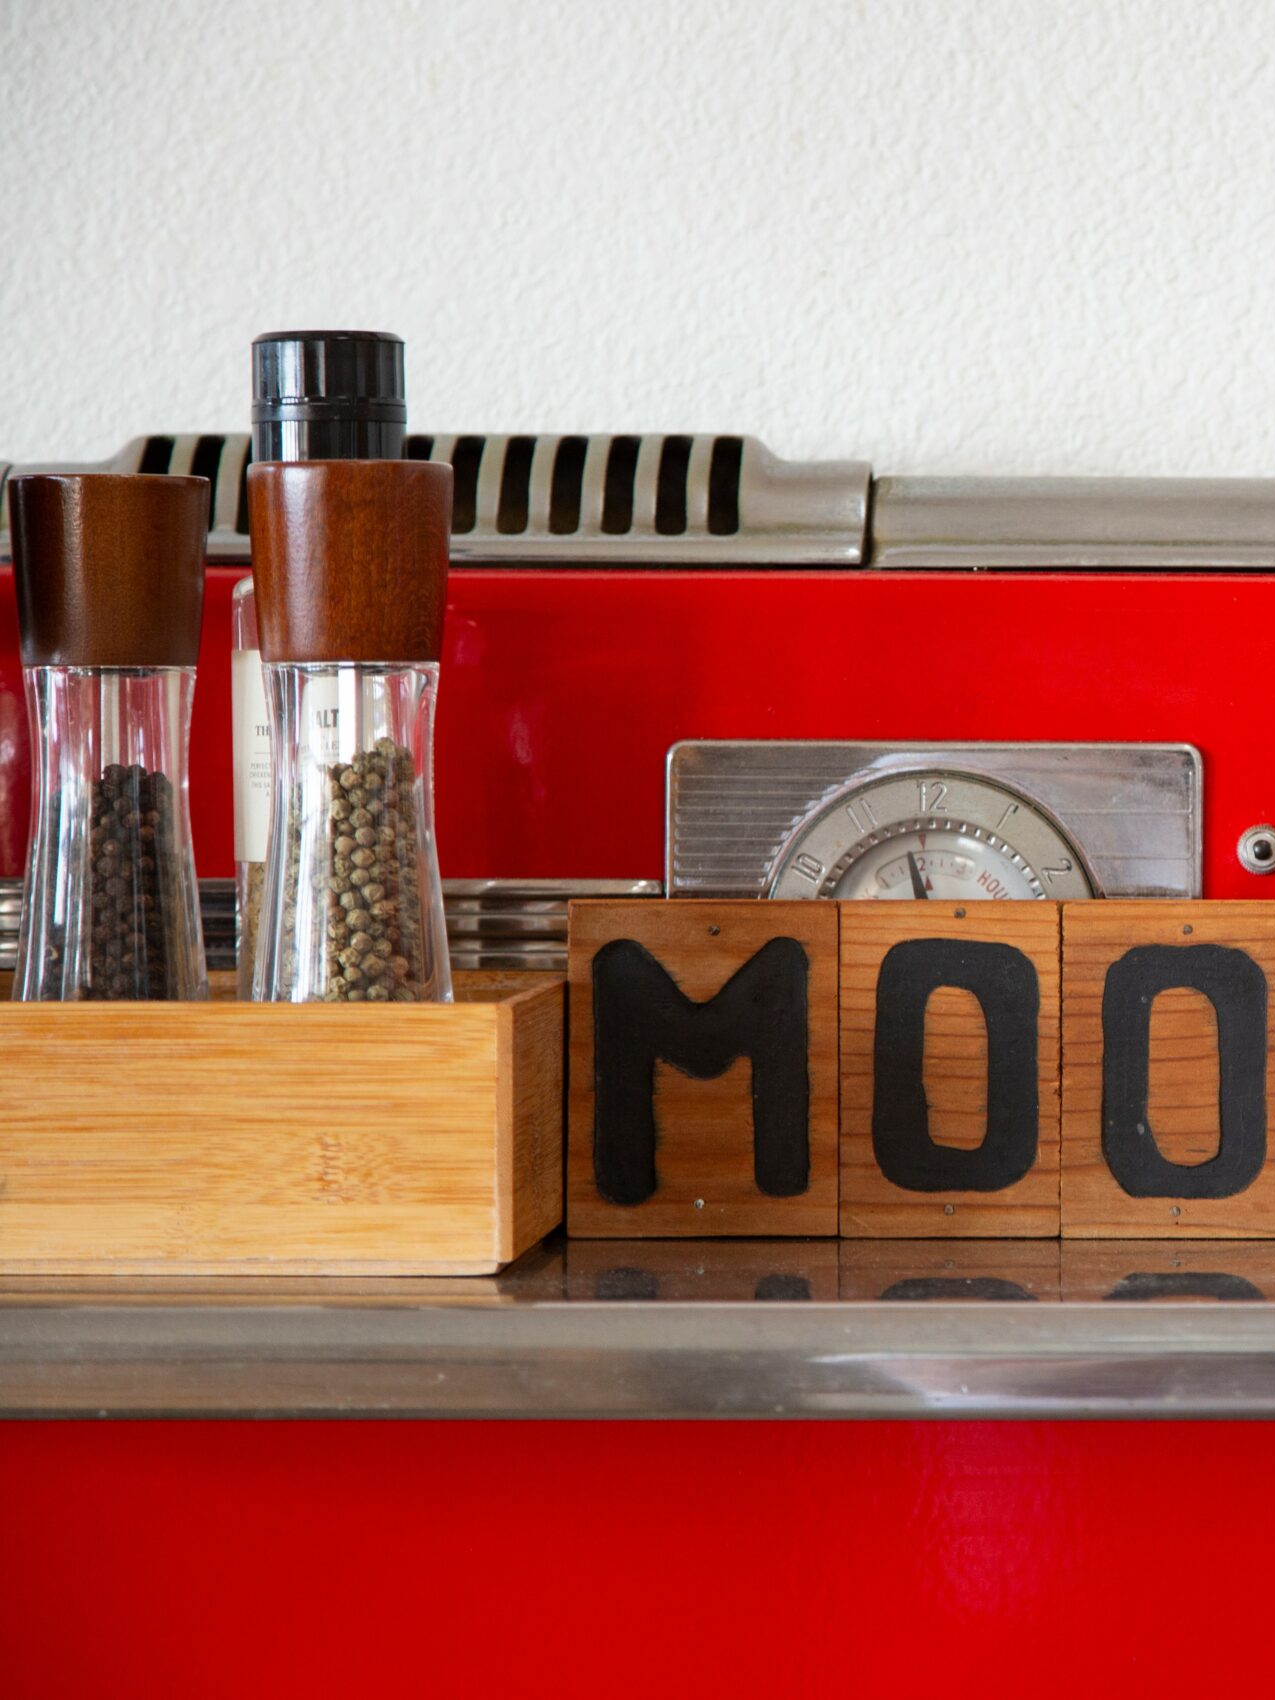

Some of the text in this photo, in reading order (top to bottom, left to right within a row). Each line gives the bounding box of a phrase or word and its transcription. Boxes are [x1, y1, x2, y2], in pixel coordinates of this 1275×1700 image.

[916, 779, 950, 813] 12
[916, 856, 927, 872] 2
[1040, 857, 1073, 885] 2
[976, 869, 1009, 900] HOU
